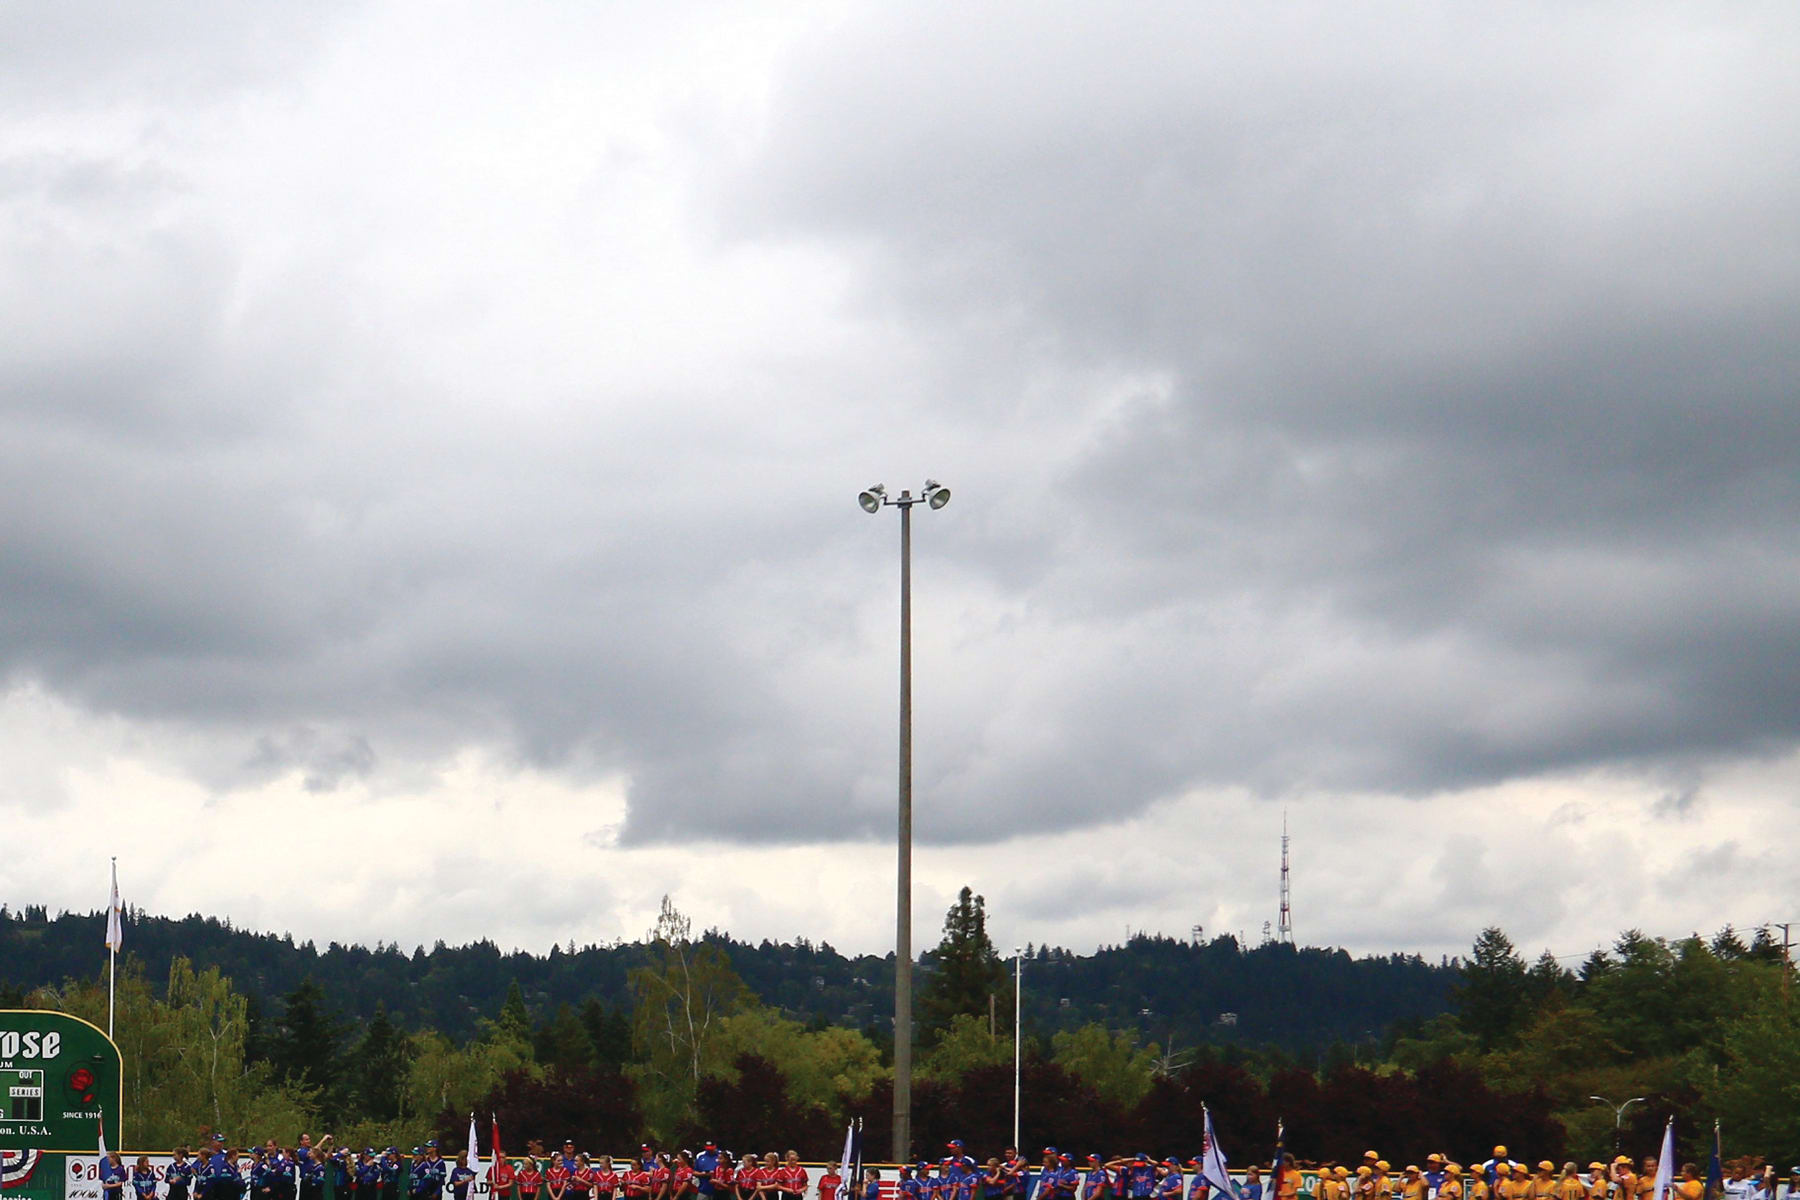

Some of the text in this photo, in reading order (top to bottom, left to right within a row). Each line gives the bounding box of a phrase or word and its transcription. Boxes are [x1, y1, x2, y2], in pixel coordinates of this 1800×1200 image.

[19, 1071, 33, 1079] OUT
[11, 1088, 40, 1096] SERIES
[62, 1111, 83, 1119] SINCE
[19, 1126, 52, 1136] U.S.A.
